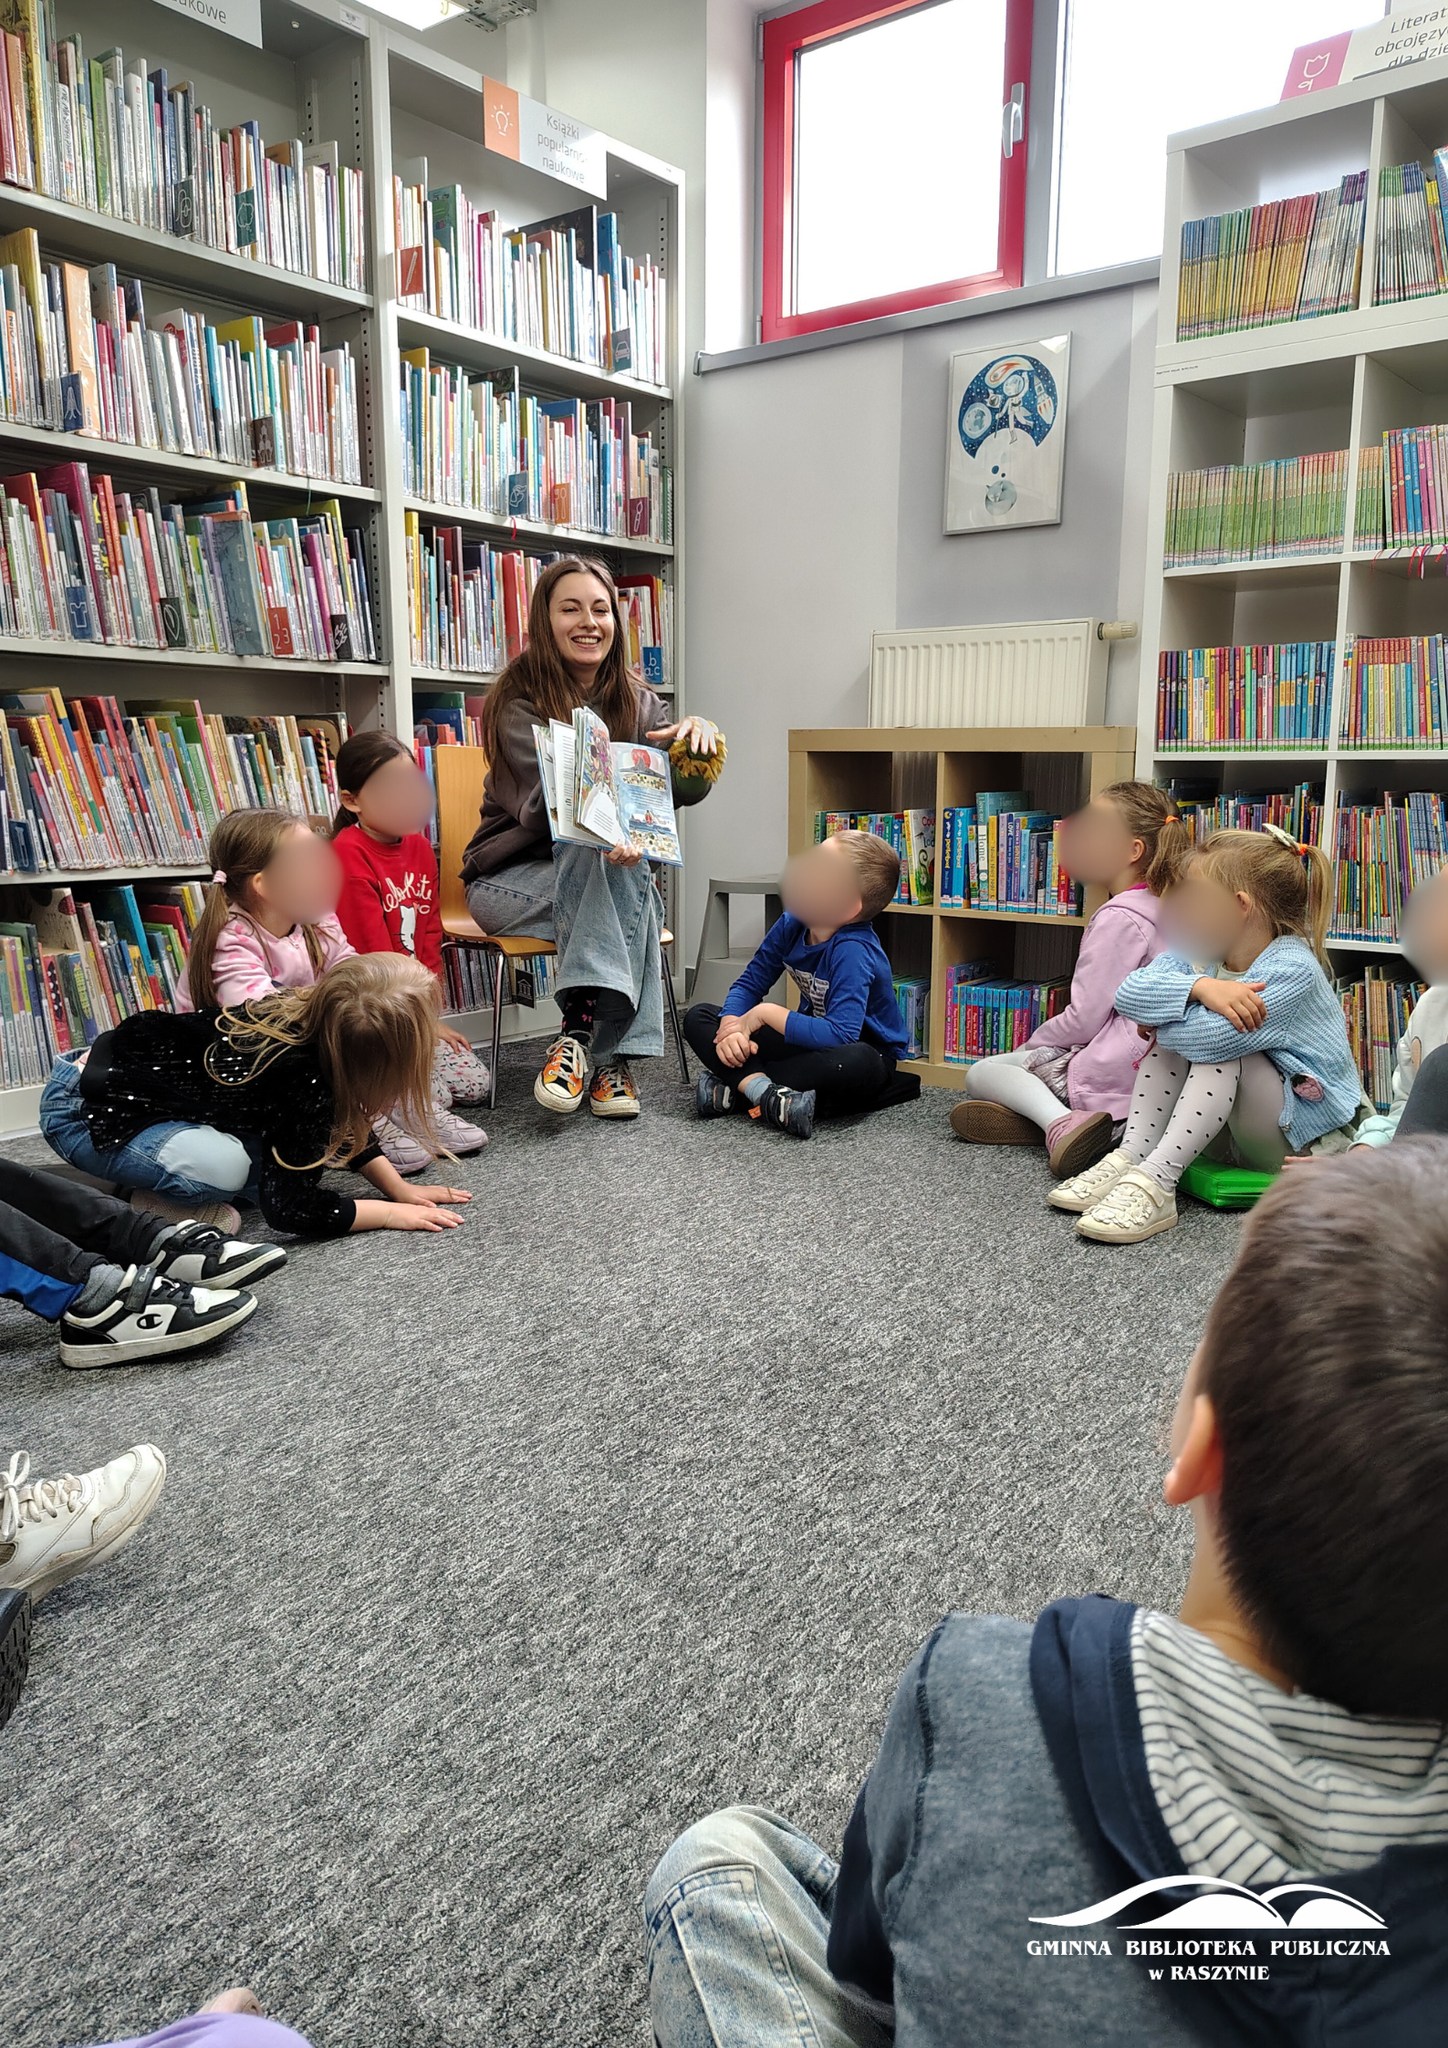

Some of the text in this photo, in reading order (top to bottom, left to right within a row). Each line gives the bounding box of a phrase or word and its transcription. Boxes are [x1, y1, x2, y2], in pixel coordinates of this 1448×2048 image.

[1374, 26, 1448, 57] obcojęzy
[546, 113, 580, 140] Książki
[542, 156, 585, 184] naukowe
